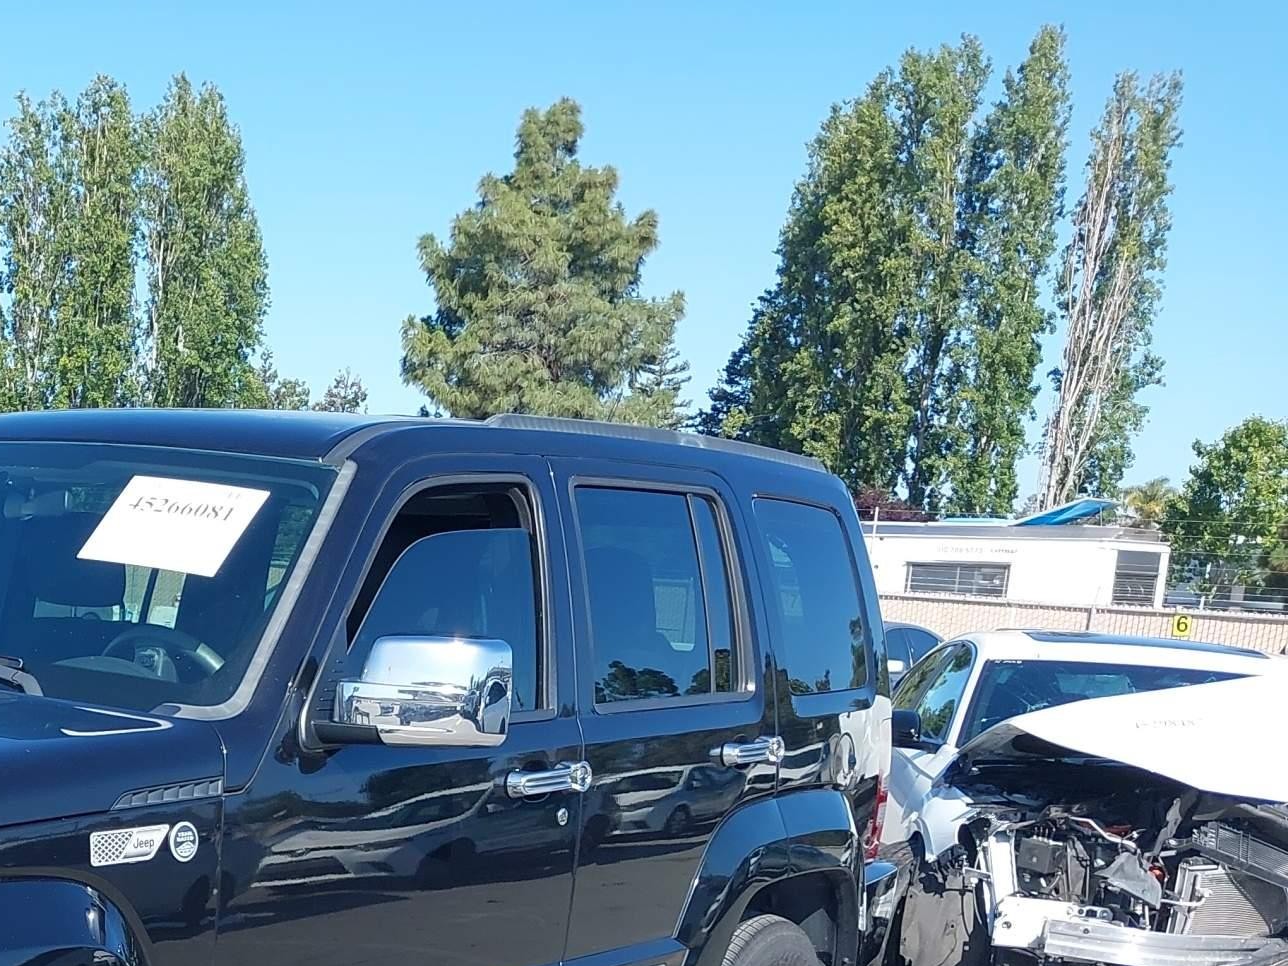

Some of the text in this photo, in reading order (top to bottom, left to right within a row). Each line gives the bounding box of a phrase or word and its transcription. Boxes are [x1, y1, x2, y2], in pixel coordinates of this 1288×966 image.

[128, 496, 234, 521] 45266081
[1177, 615, 1188, 632] 6
[133, 838, 155, 849] Jeep
